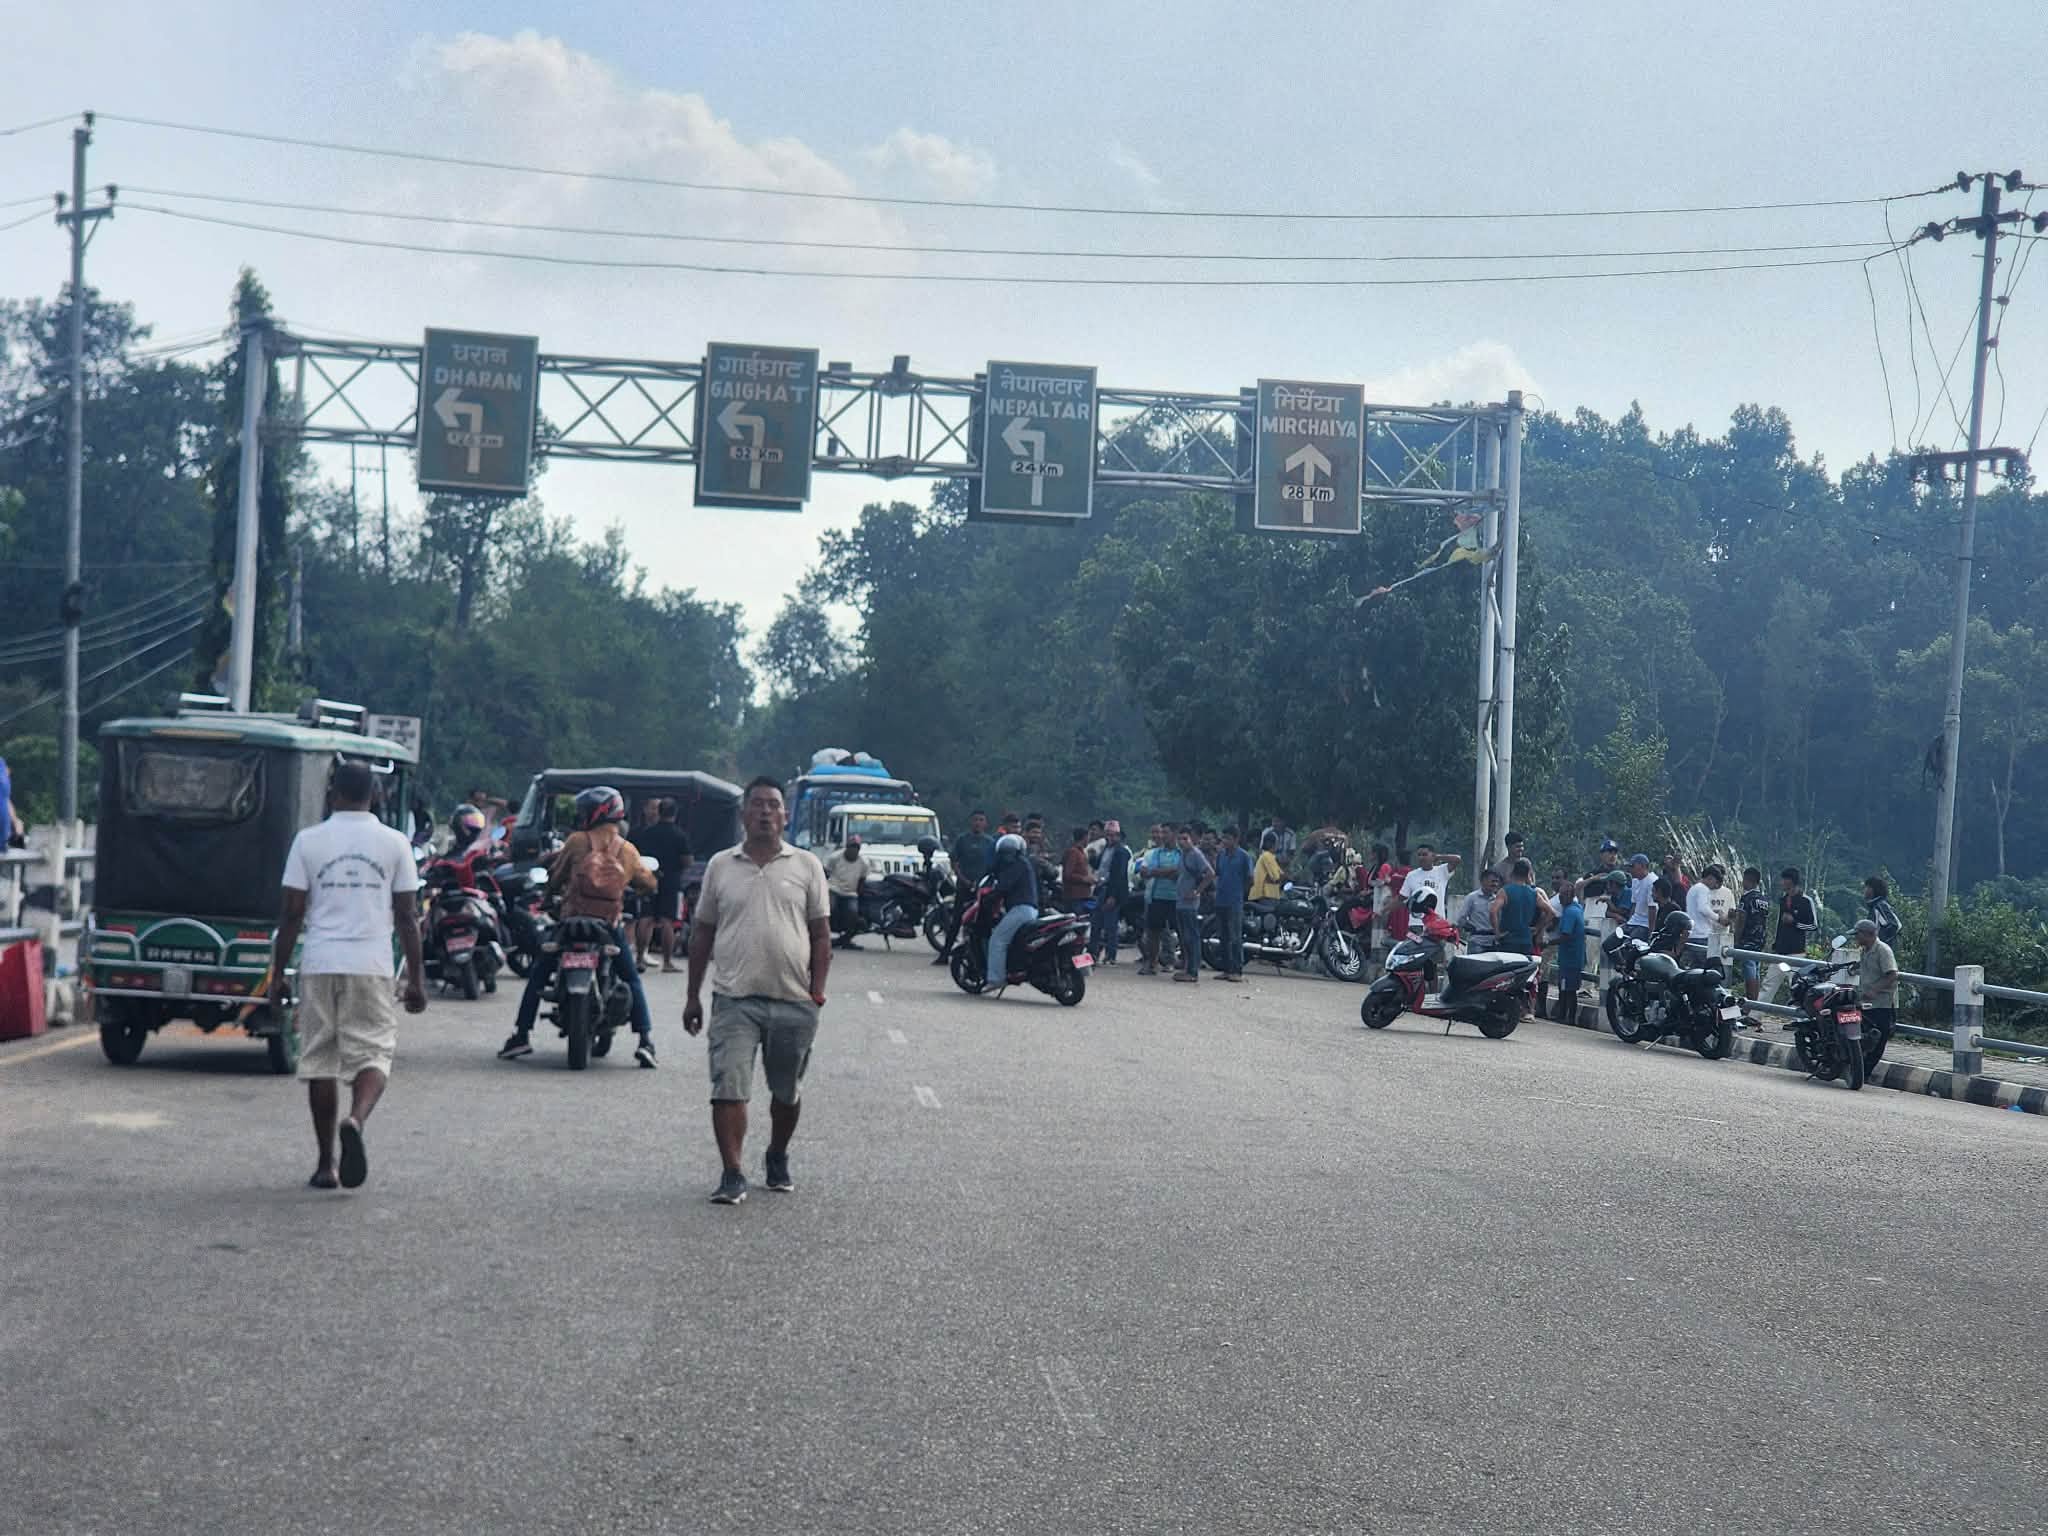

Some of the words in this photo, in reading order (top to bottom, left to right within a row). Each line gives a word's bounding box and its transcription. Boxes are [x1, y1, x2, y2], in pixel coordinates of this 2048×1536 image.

[434, 366, 522, 392] DHARAN
[1000, 368, 1088, 398] नेपालटार
[710, 381, 810, 404] GAIGHAT
[990, 397, 1090, 420] NEPALTAR
[1261, 415, 1358, 438] MIRCHAIYA
[1015, 462, 1035, 473] 24
[1039, 464, 1059, 475] Km
[1288, 486, 1305, 499] 28
[1309, 488, 1331, 501] Km
